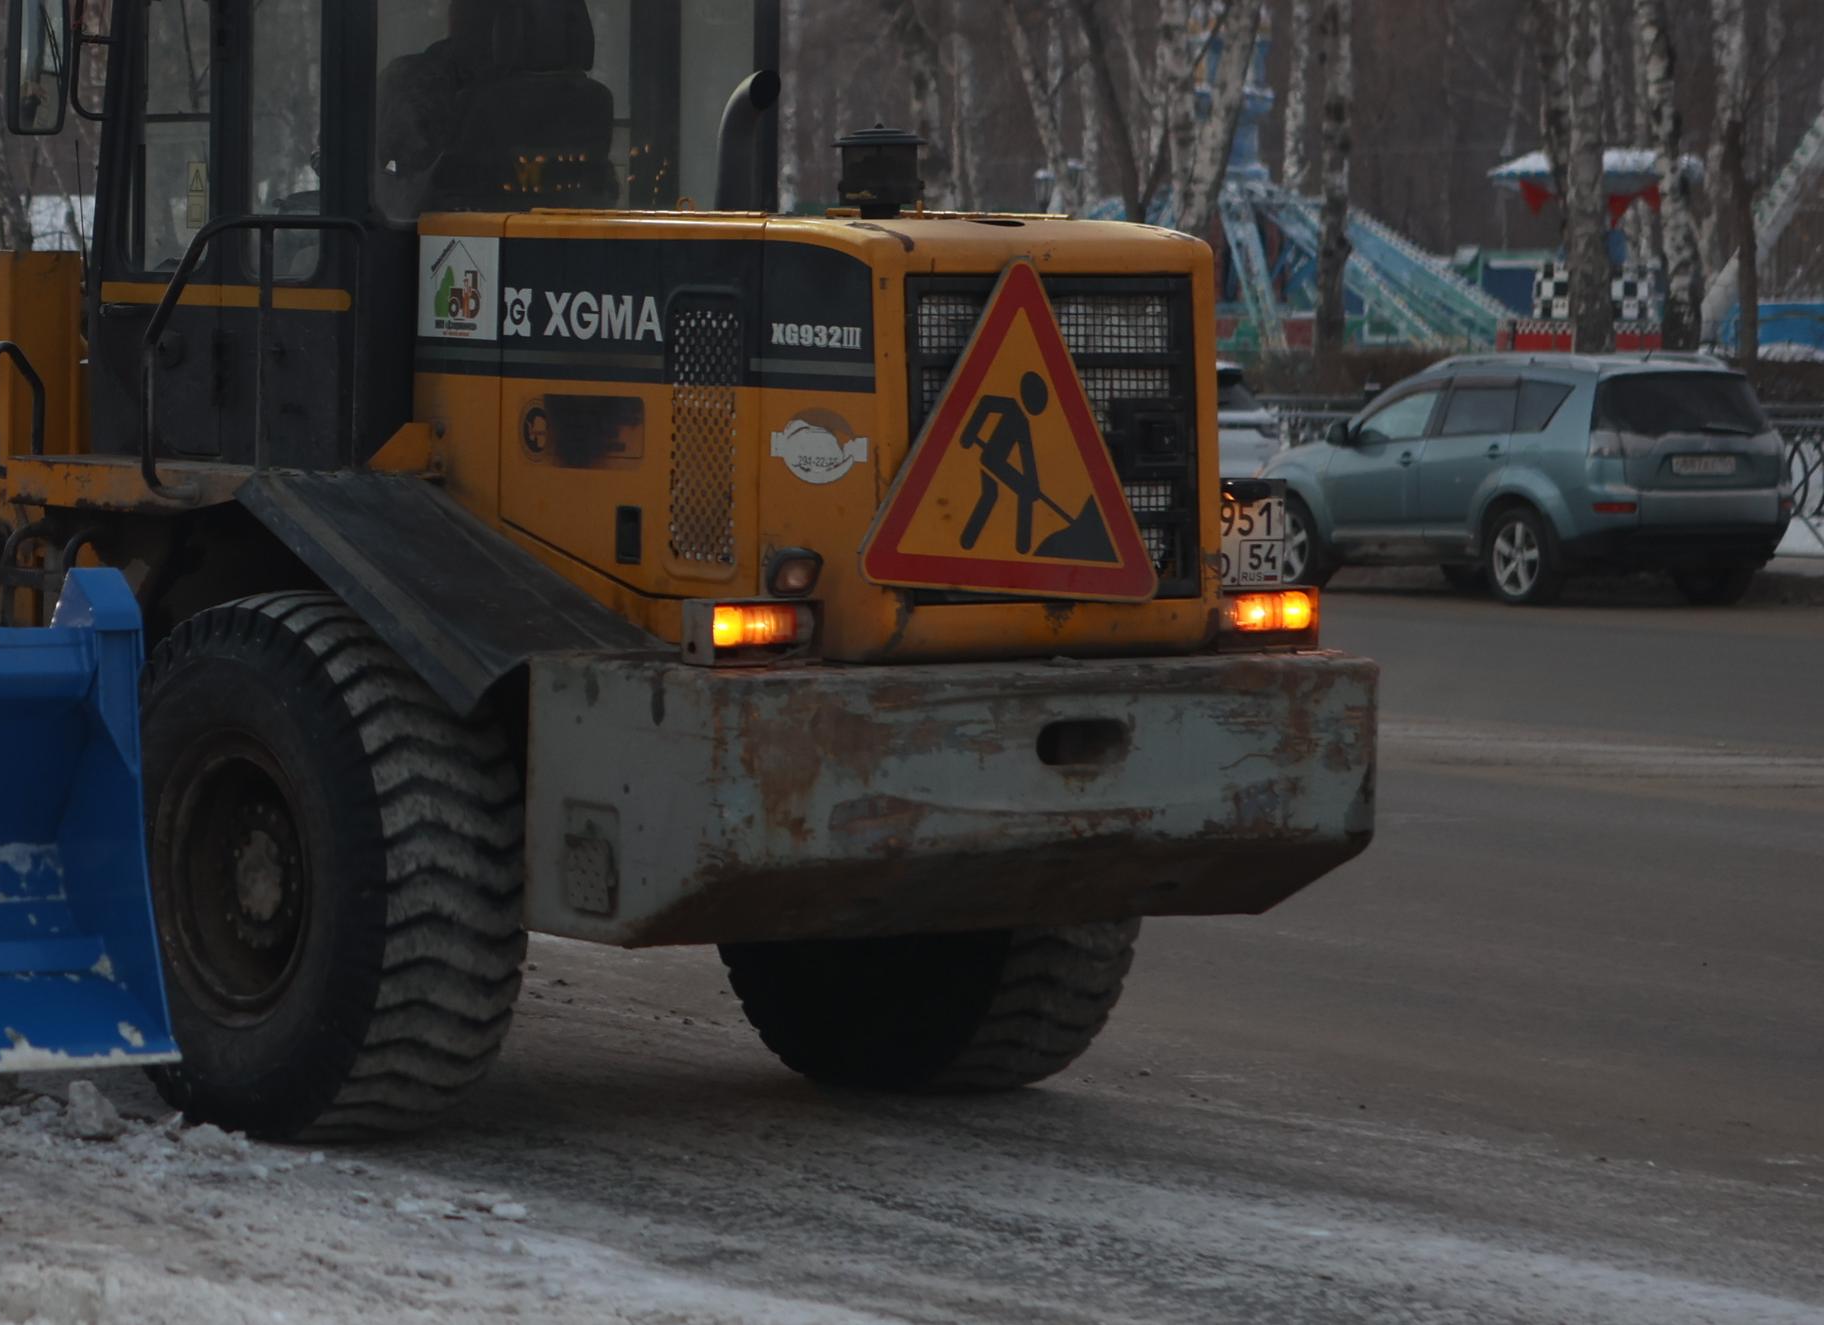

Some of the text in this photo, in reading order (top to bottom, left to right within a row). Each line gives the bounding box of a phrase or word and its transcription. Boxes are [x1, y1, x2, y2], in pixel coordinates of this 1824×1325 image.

[543, 290, 664, 342] XGMA
[1248, 543, 1277, 571] 54
[1241, 572, 1263, 582] RUS
